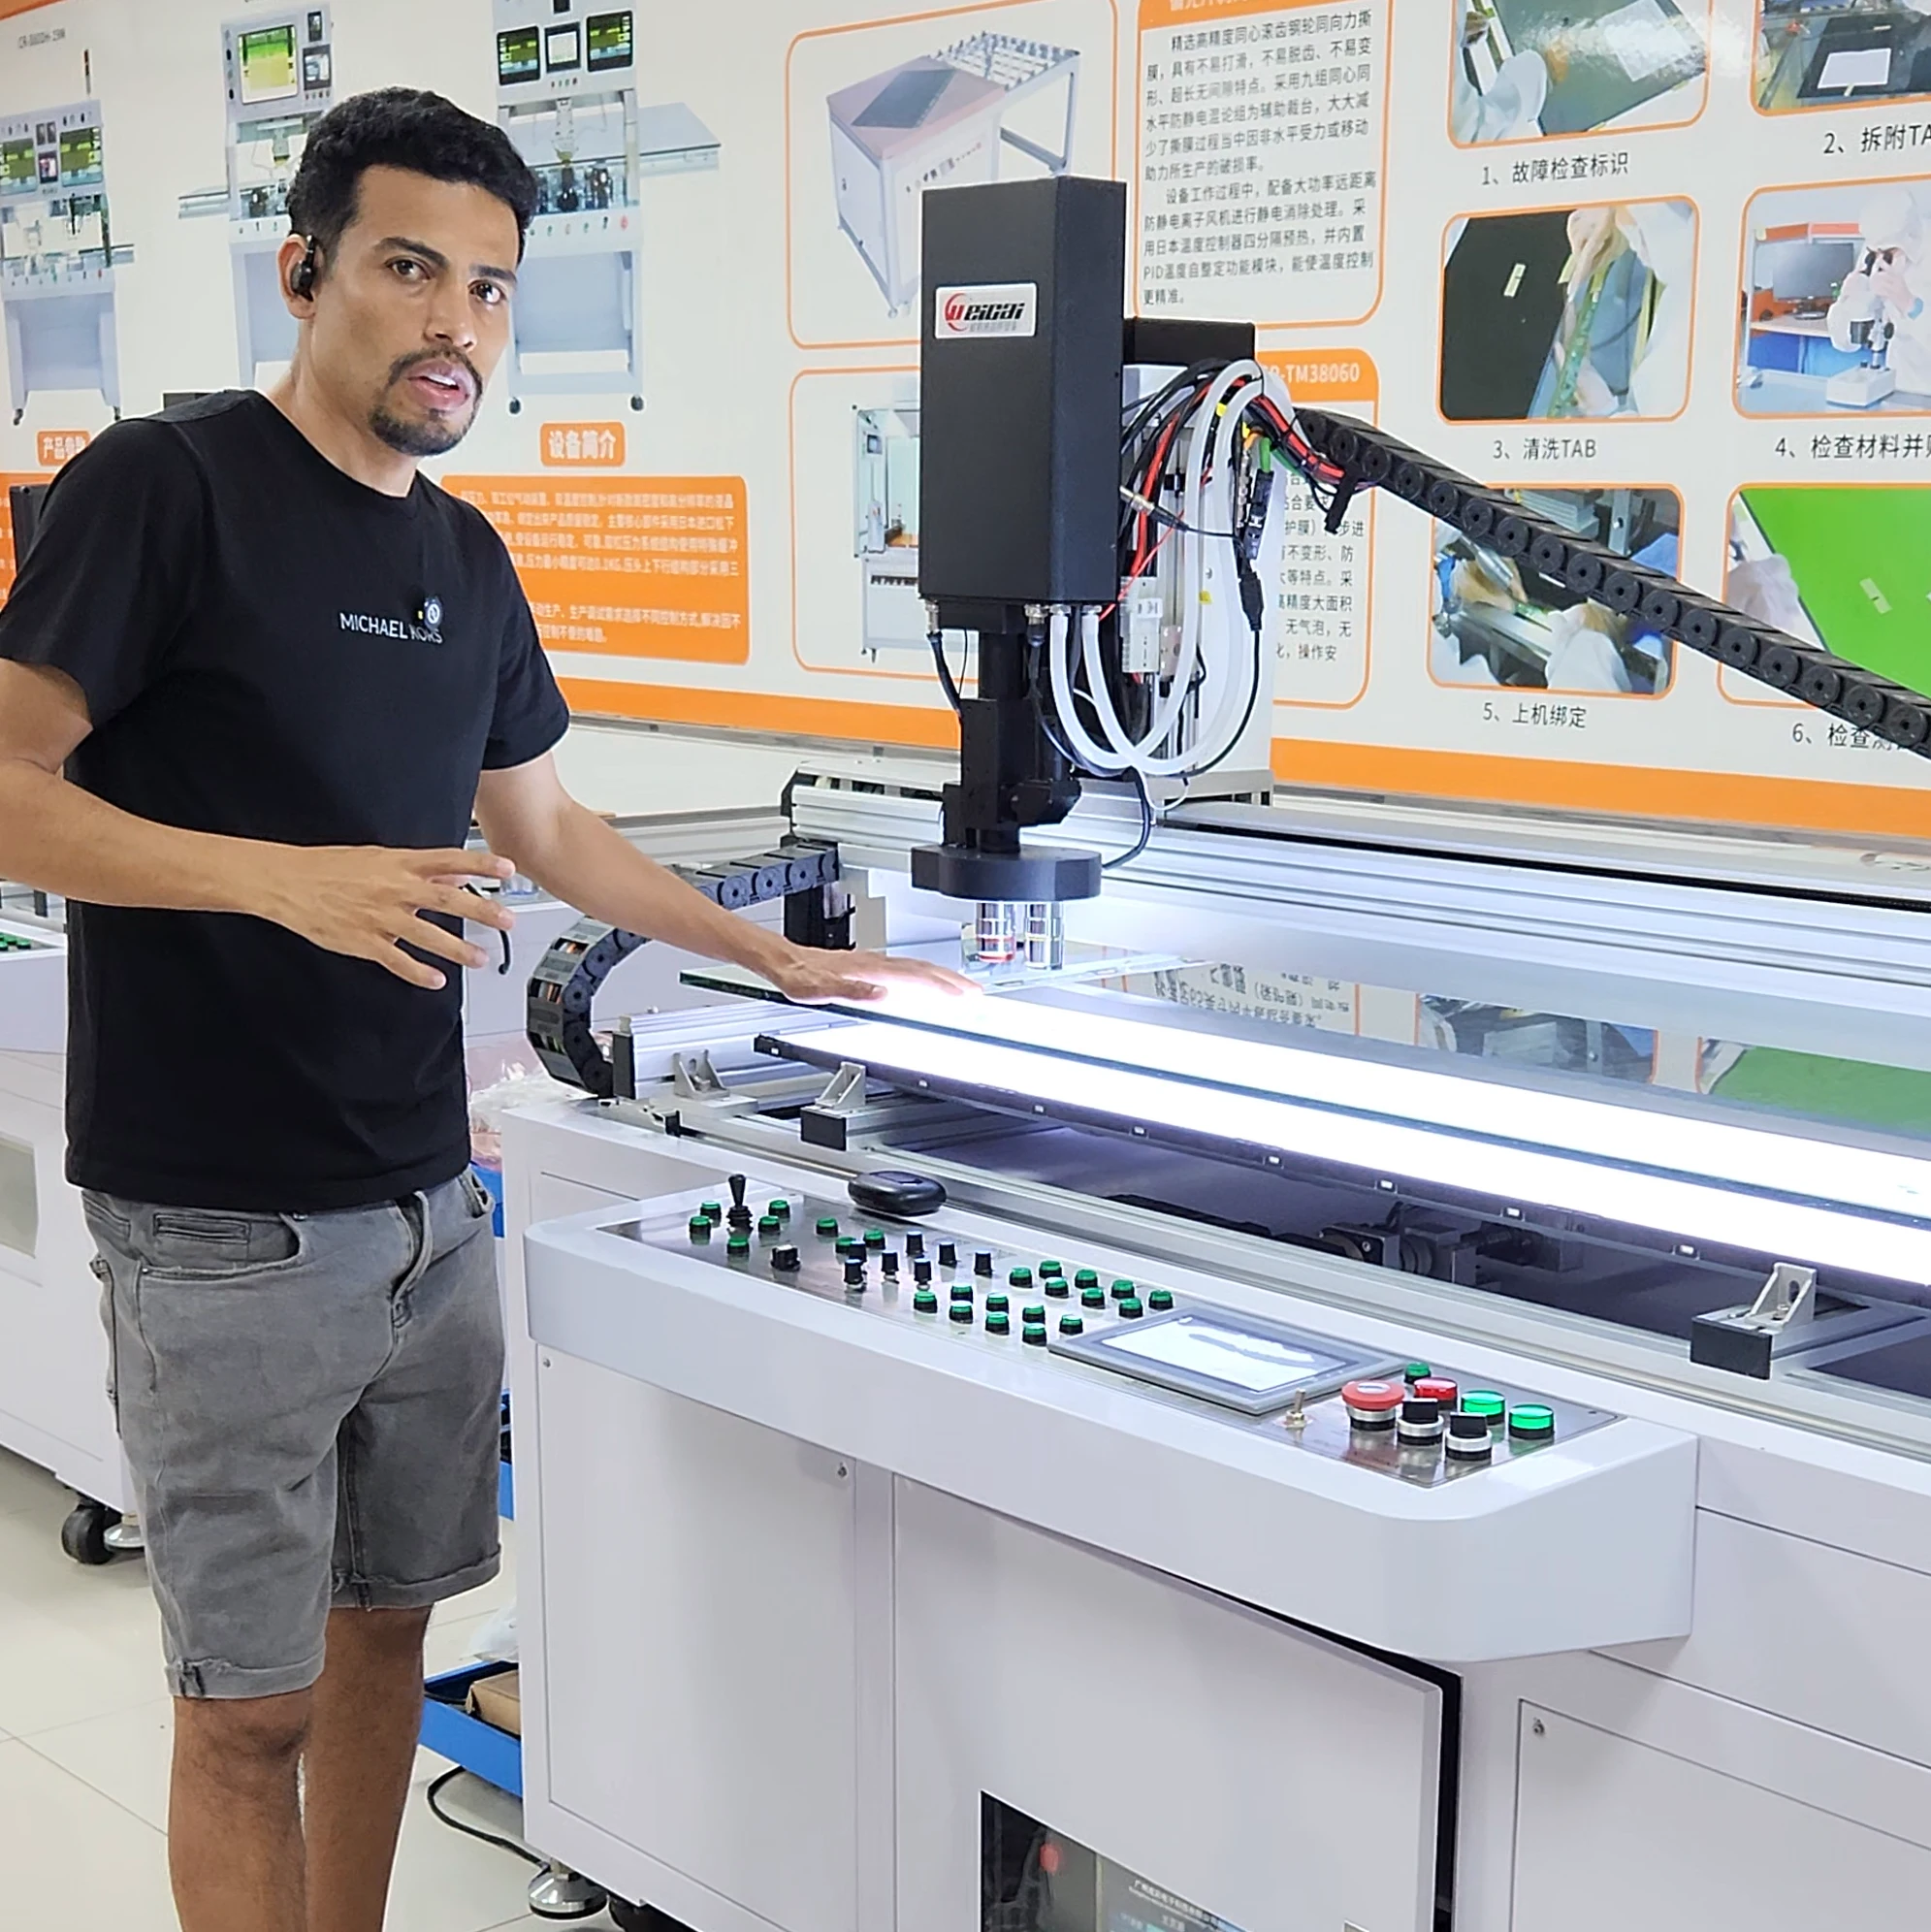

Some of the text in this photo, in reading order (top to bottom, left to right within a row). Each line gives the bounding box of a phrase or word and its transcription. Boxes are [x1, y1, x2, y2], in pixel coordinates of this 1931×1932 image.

[1483, 152, 1629, 186] 1、故障检查标识
[548, 429, 616, 460] 设备简介
[1494, 437, 1597, 460] 3、清洗TAB
[339, 612, 408, 639] MICHAEL
[1483, 702, 1587, 729] 5、上机绑定
